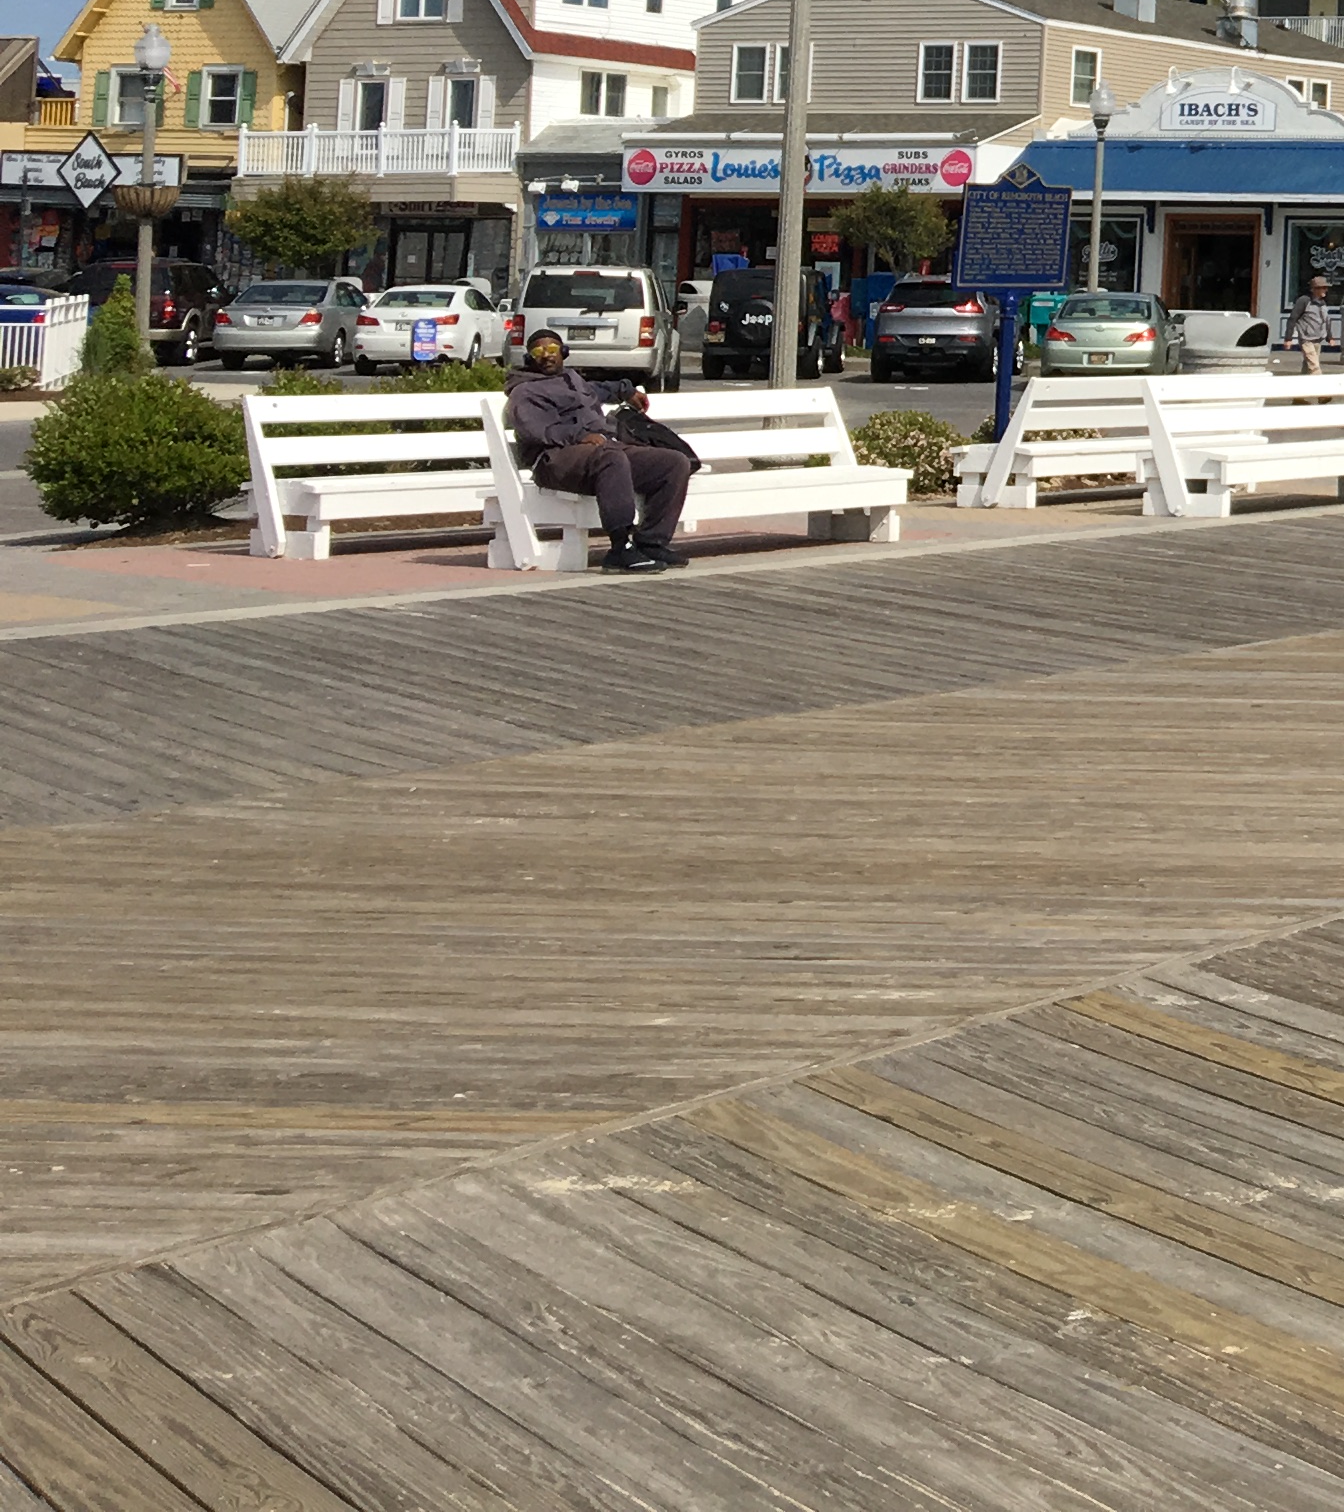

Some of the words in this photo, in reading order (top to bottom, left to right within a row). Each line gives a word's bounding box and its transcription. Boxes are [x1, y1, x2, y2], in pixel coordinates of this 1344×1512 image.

[1178, 102, 1259, 118] IBACH'S
[664, 150, 704, 159] GYROS
[897, 150, 929, 160] SUBS
[71, 152, 104, 171] South
[658, 162, 709, 174] PIZZA
[710, 151, 781, 183] Louie's
[813, 153, 882, 186] Pizza
[882, 162, 940, 175] GRINDERS
[73, 172, 107, 190] Beach
[663, 176, 703, 185] SALADS
[893, 177, 931, 186] STEAKS
[968, 191, 986, 199] CITY
[989, 191, 998, 200] OF
